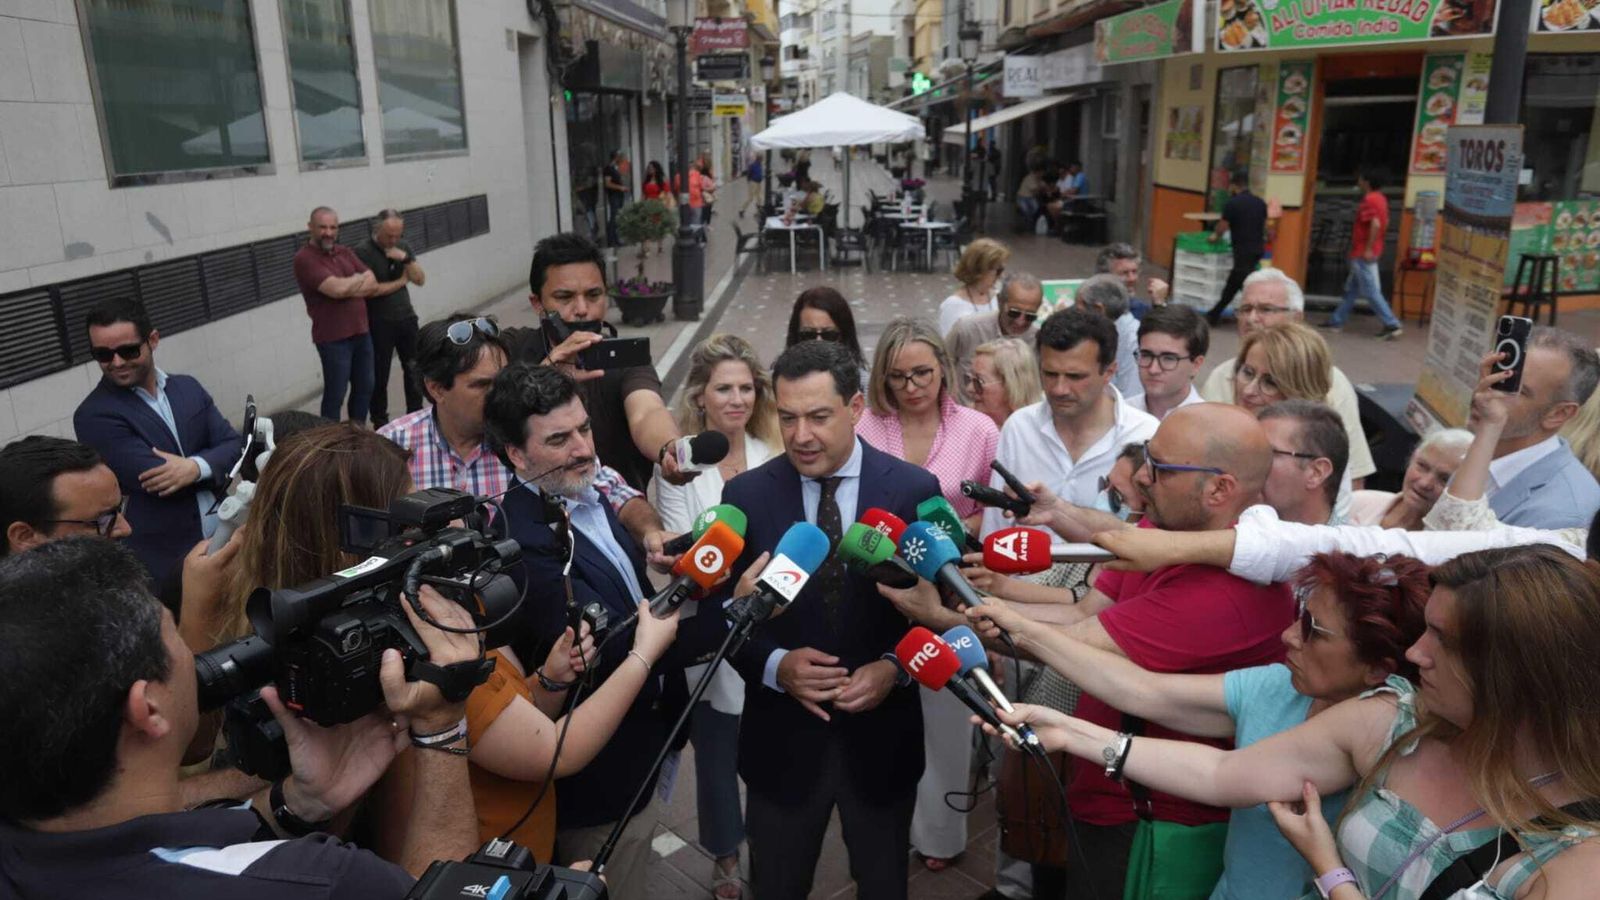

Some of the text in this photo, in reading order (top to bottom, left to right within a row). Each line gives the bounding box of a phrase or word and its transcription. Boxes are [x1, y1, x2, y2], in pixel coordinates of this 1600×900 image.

[1271, 3, 1298, 32] ALI
[1295, 19, 1399, 38] Comida India
[1459, 138, 1505, 172] TOROS
[908, 642, 940, 673] rne
[463, 884, 491, 895] 4K
